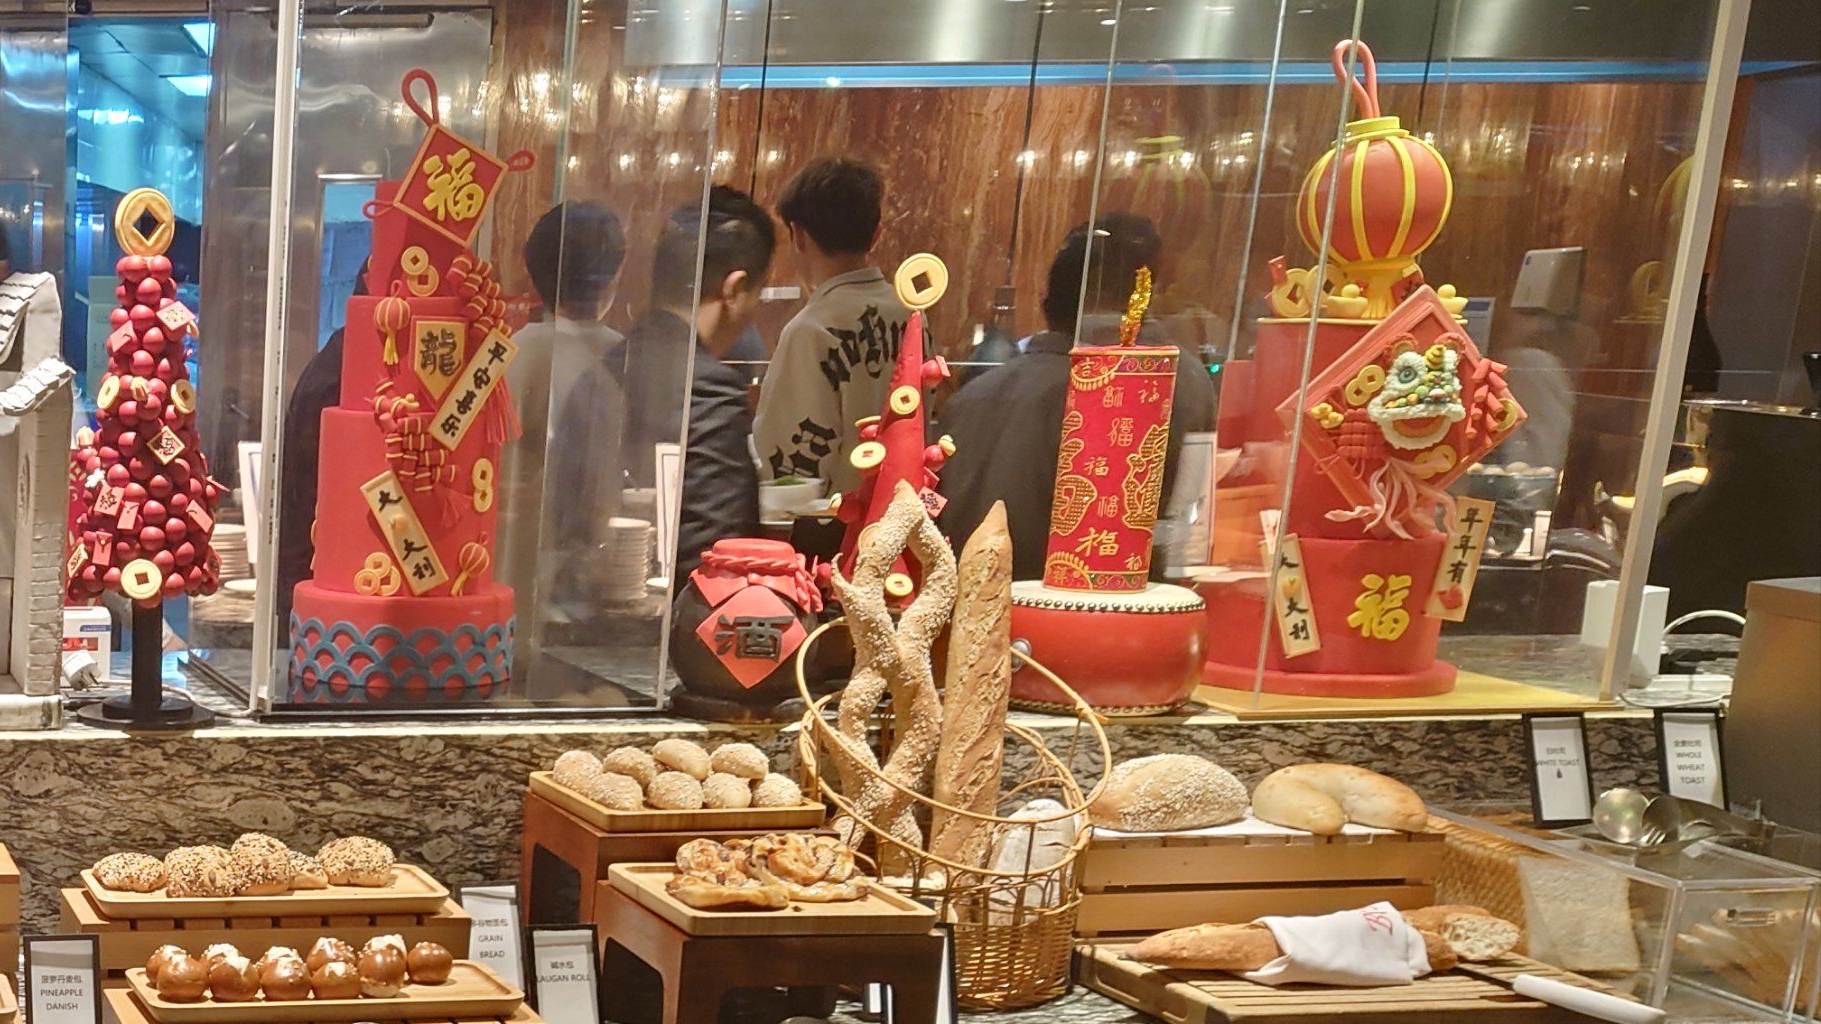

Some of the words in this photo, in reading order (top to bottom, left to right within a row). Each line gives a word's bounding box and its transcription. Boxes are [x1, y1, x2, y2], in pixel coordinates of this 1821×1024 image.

[423, 147, 484, 222] 福
[420, 328, 461, 377] 龍
[1075, 527, 1120, 559] 福
[1347, 573, 1410, 641] 福
[715, 613, 795, 663] 酒
[1536, 759, 1557, 767] WHITE
[1558, 759, 1580, 767] TOAST
[1680, 776, 1706, 785] TOAST
[478, 935, 503, 943] GRAIN
[480, 951, 505, 959] BREAD
[571, 973, 591, 982] ROLL
[40, 989, 84, 997] PINEAPPLE
[46, 1003, 78, 1011] DANISH
